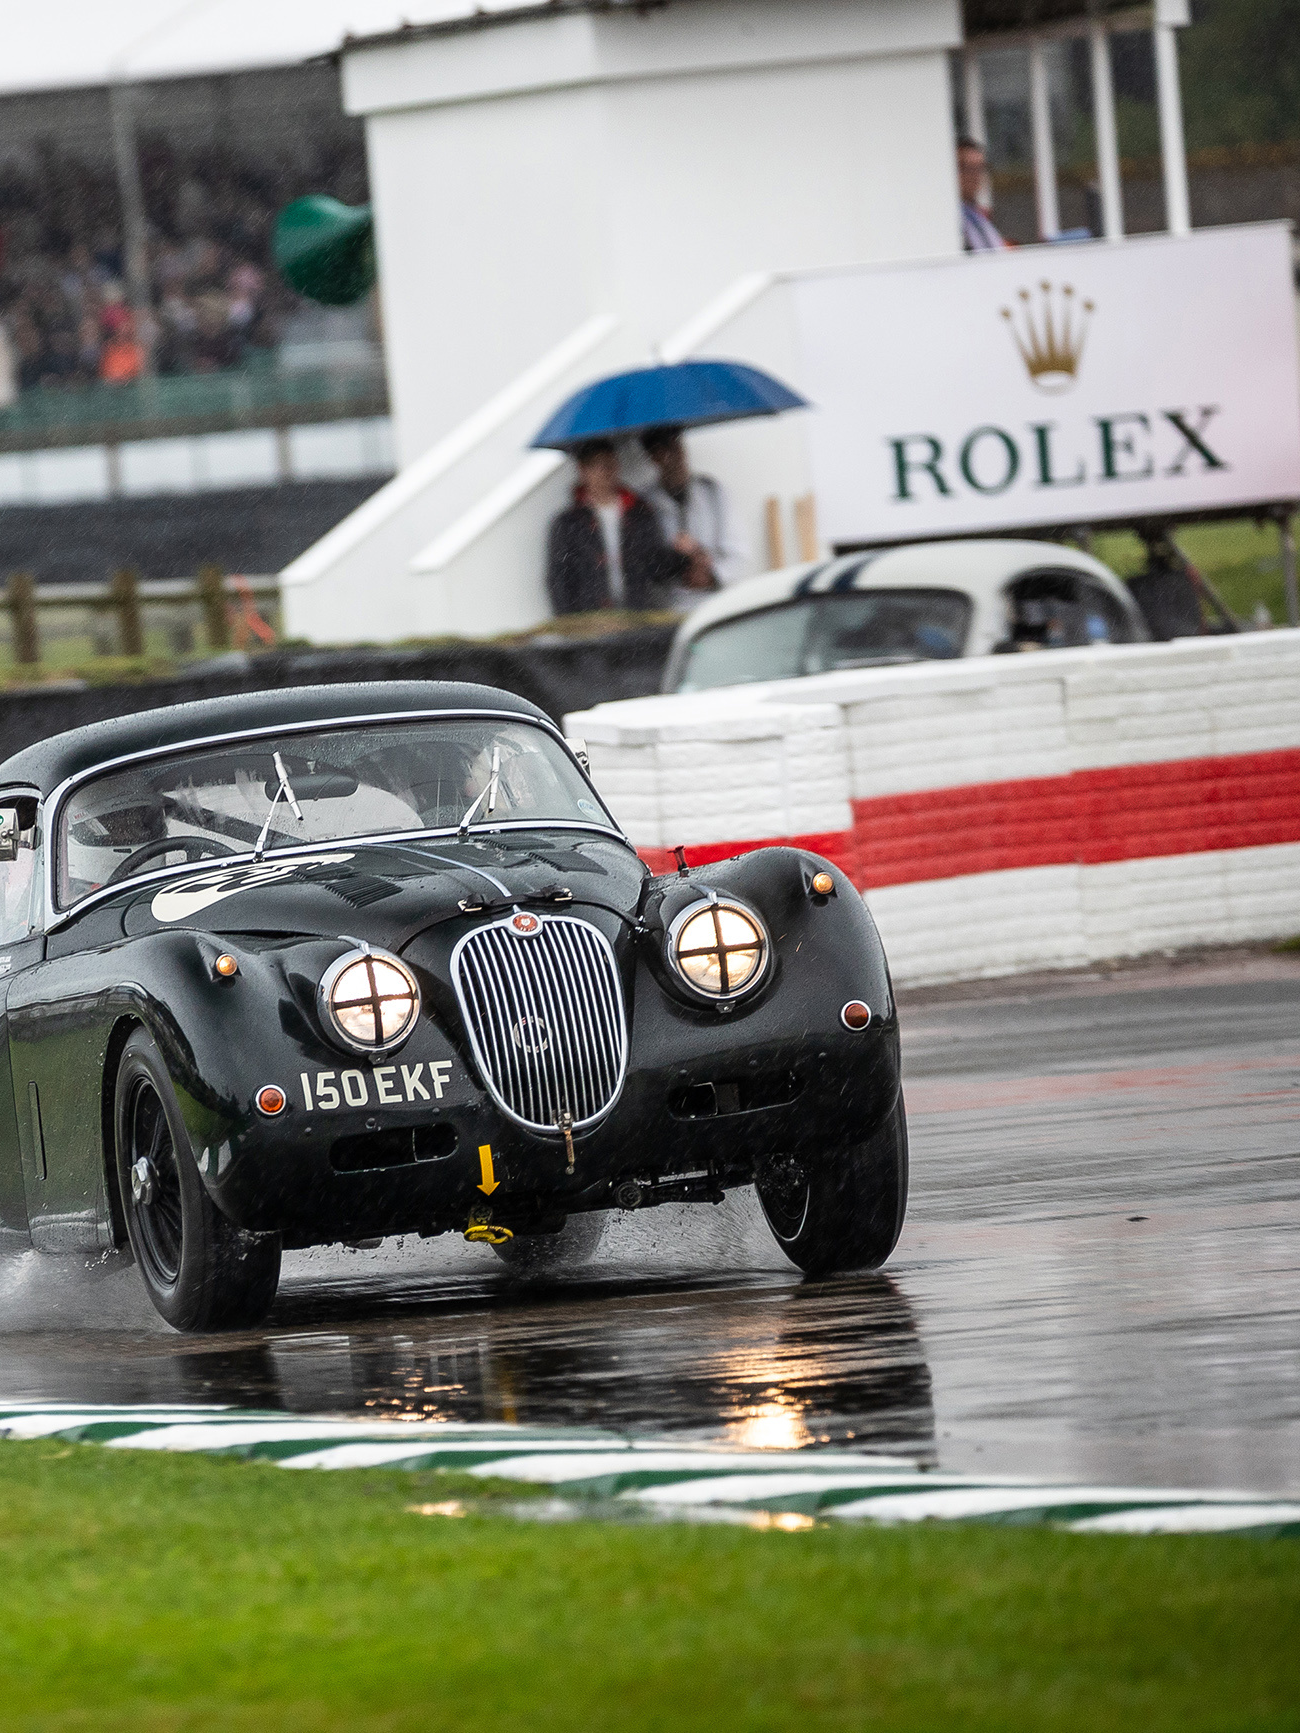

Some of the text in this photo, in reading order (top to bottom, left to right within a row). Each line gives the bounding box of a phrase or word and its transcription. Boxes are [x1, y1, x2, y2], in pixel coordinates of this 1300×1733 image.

[886, 404, 1229, 502] ROLEX
[300, 1060, 453, 1111] 150 EKF
